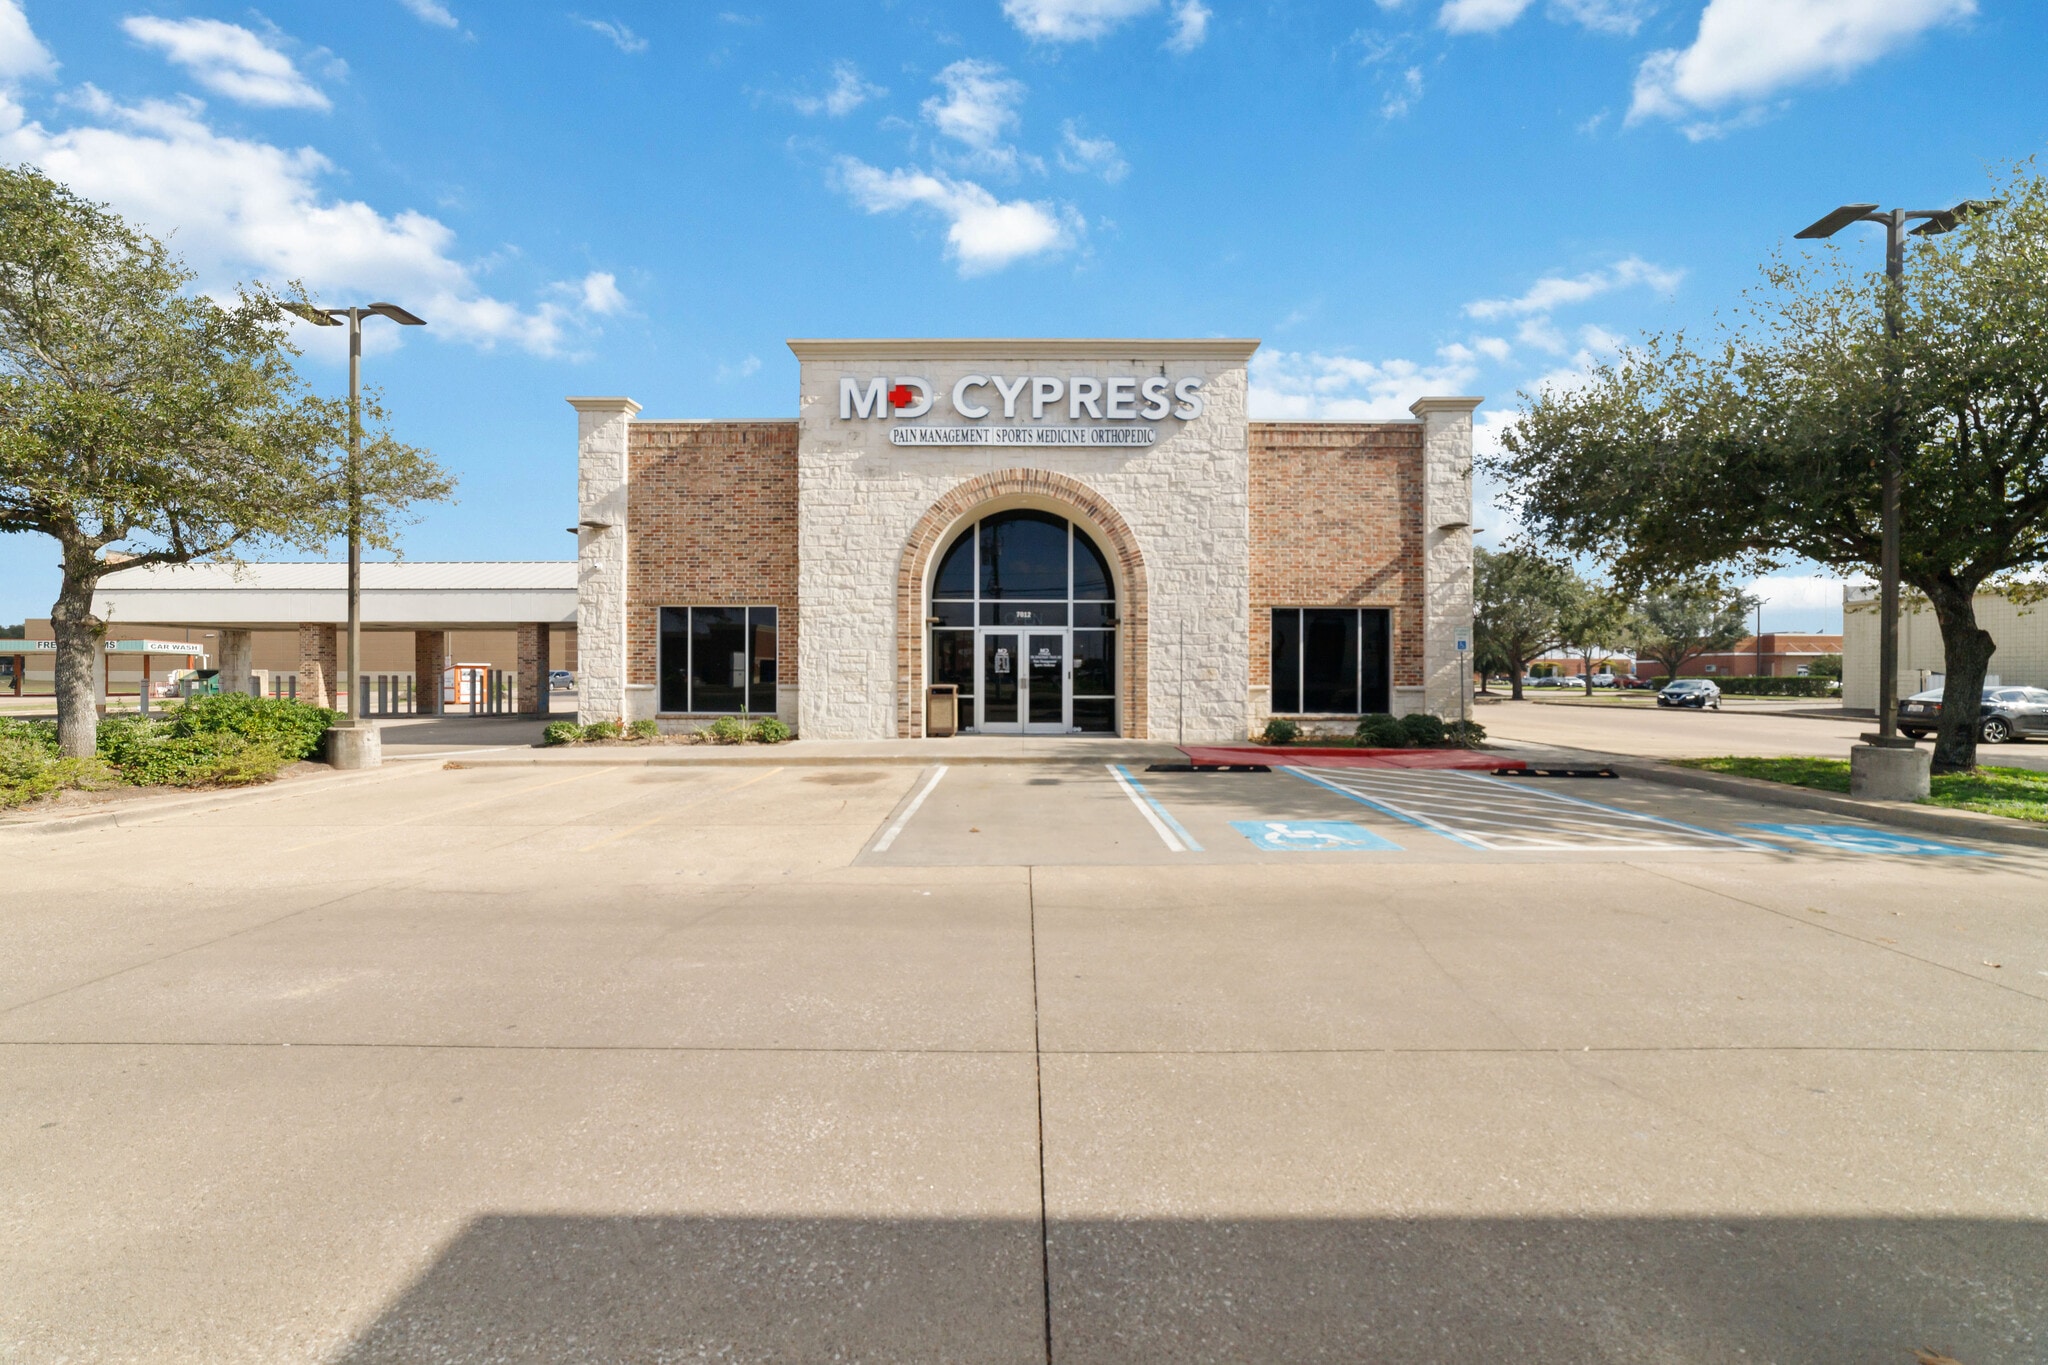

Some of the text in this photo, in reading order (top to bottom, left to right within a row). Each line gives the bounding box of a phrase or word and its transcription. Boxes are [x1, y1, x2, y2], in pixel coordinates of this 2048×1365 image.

[952, 375, 1204, 421] CYPRESS
[893, 429, 1154, 443] PAIN MANAGEMENT SPORTS MEDICINE ORTHOPEDIC
[37, 641, 57, 649] FRE
